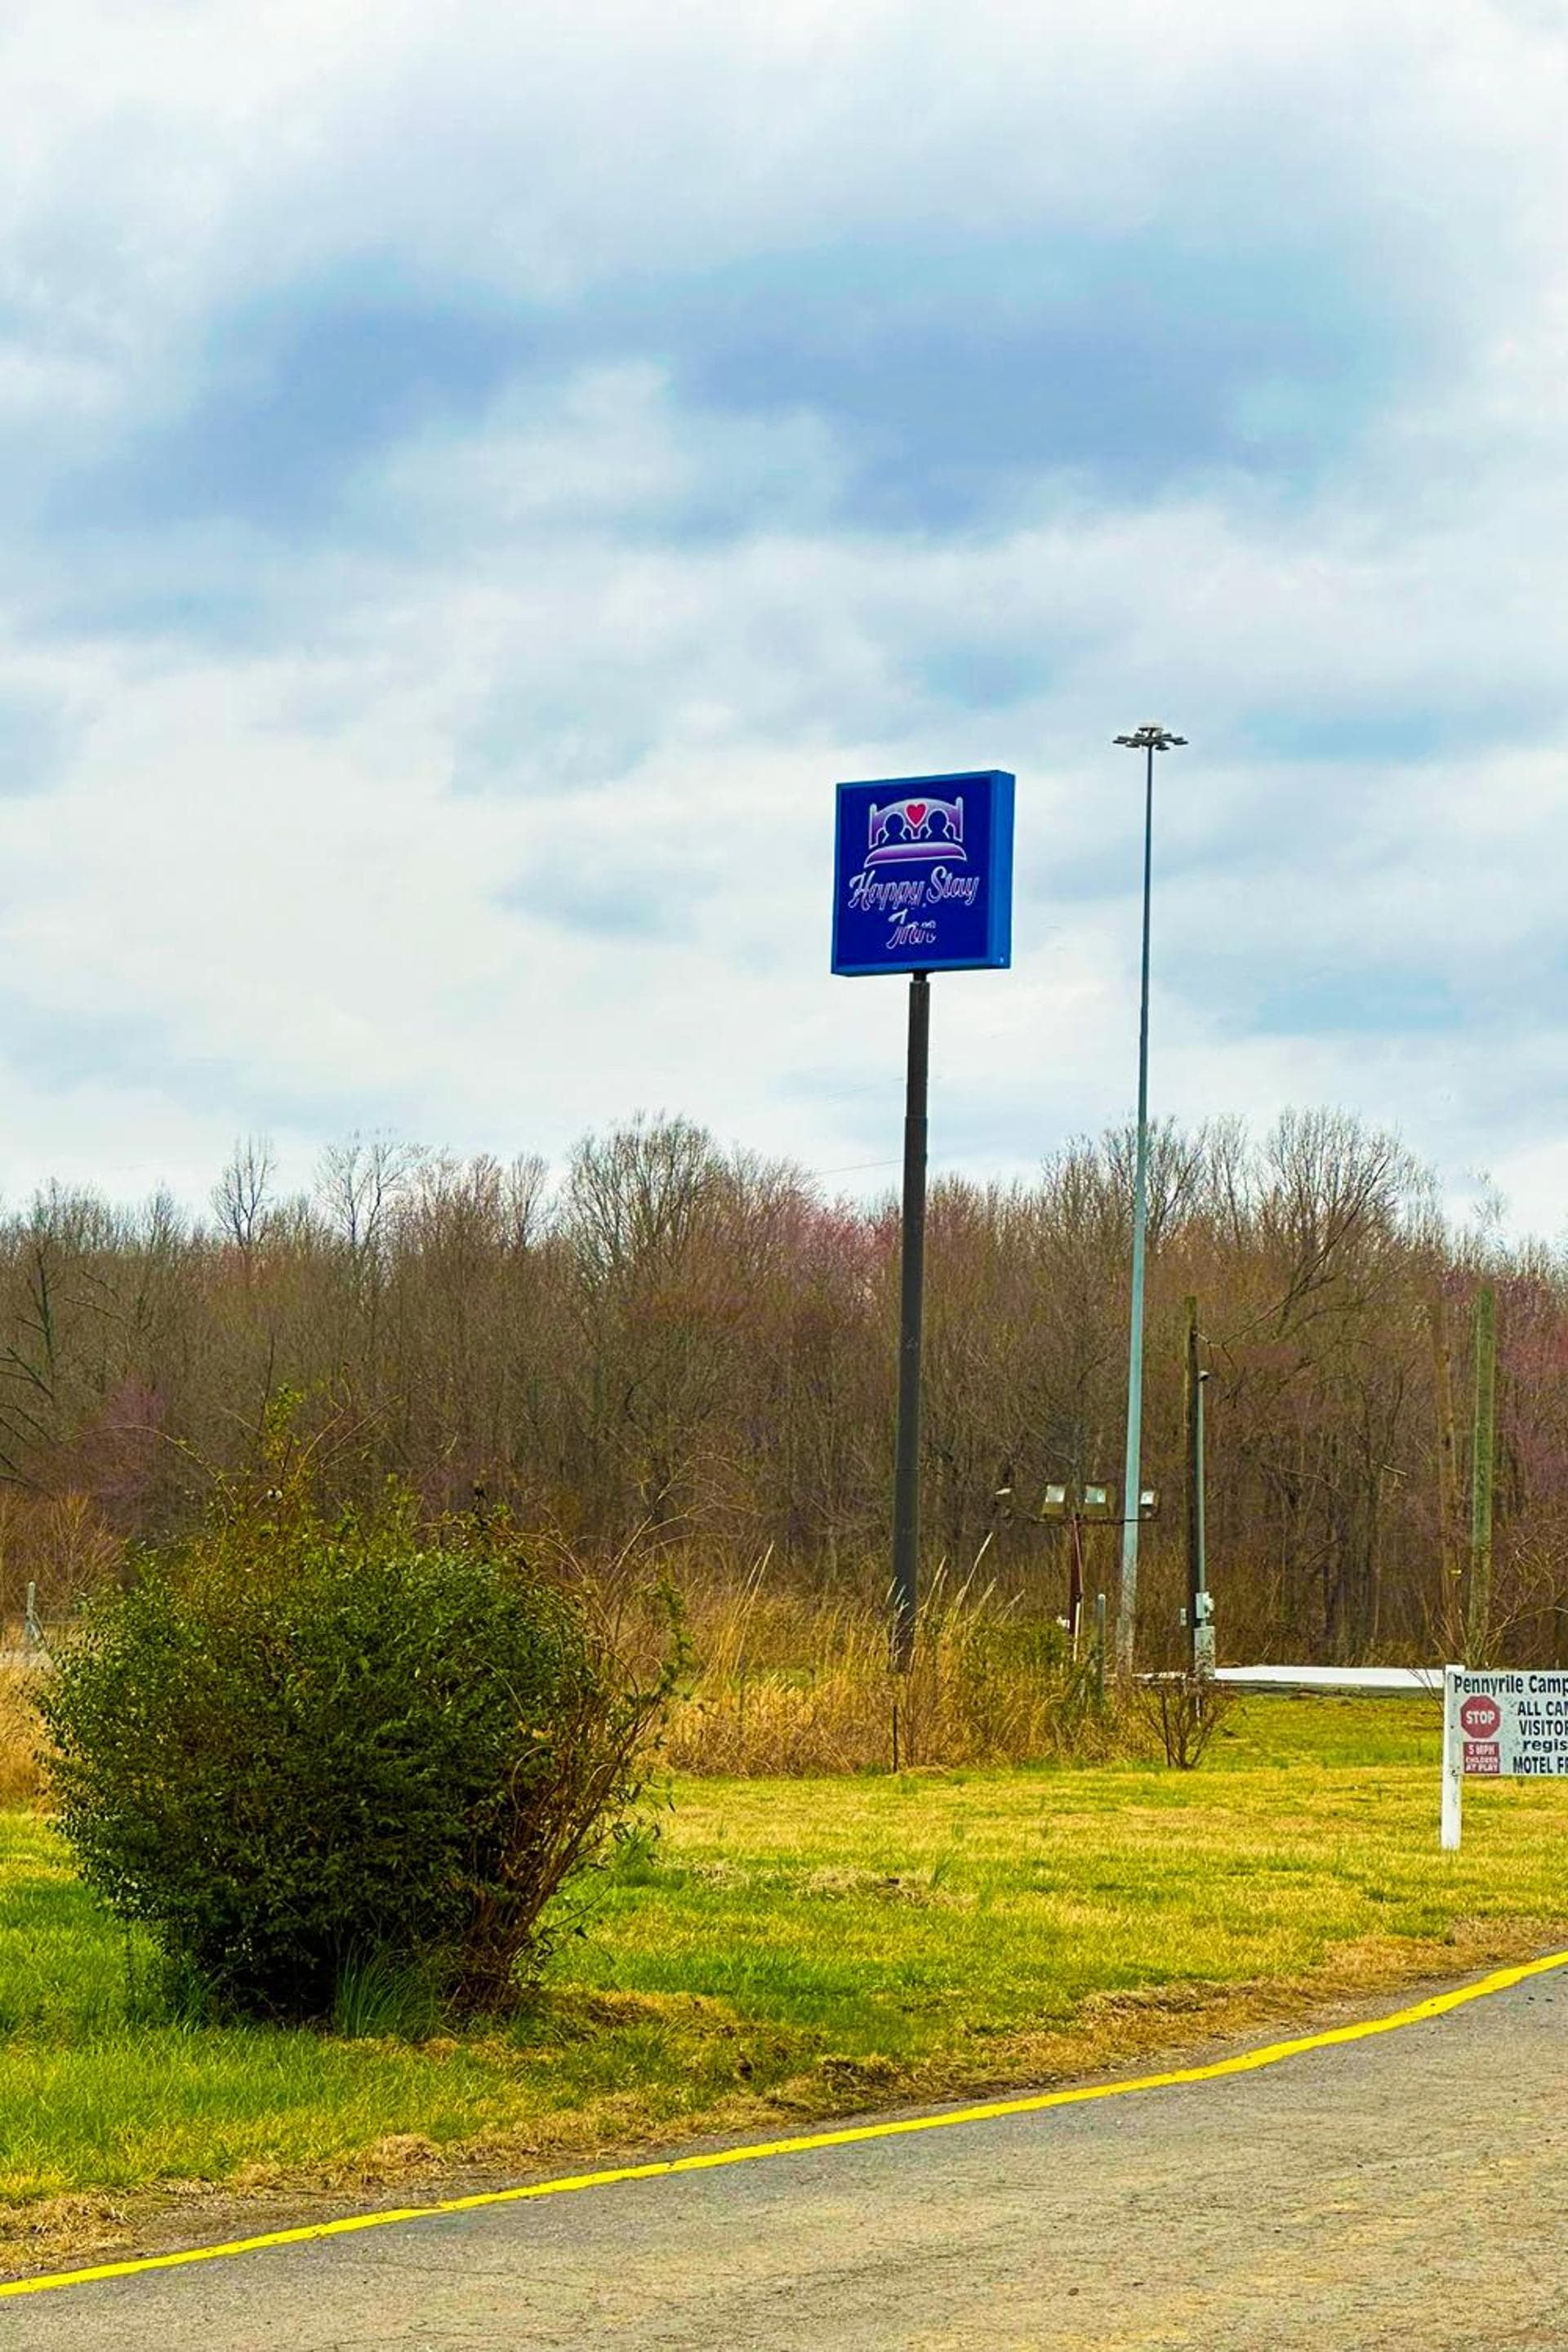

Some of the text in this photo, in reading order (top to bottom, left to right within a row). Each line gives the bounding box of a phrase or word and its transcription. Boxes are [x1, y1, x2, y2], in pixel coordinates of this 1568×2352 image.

[848, 866, 979, 911] Happy Stay
[1454, 1674, 1568, 1696] Pennyrile Camp
[1517, 1701, 1542, 1716] ALL
[1466, 1710, 1495, 1725] STOP
[1468, 1744, 1475, 1755] 5
[1522, 1739, 1568, 1753] regis
[1477, 1763, 1498, 1772] PLAY
[1512, 1756, 1553, 1774] MOTEL
